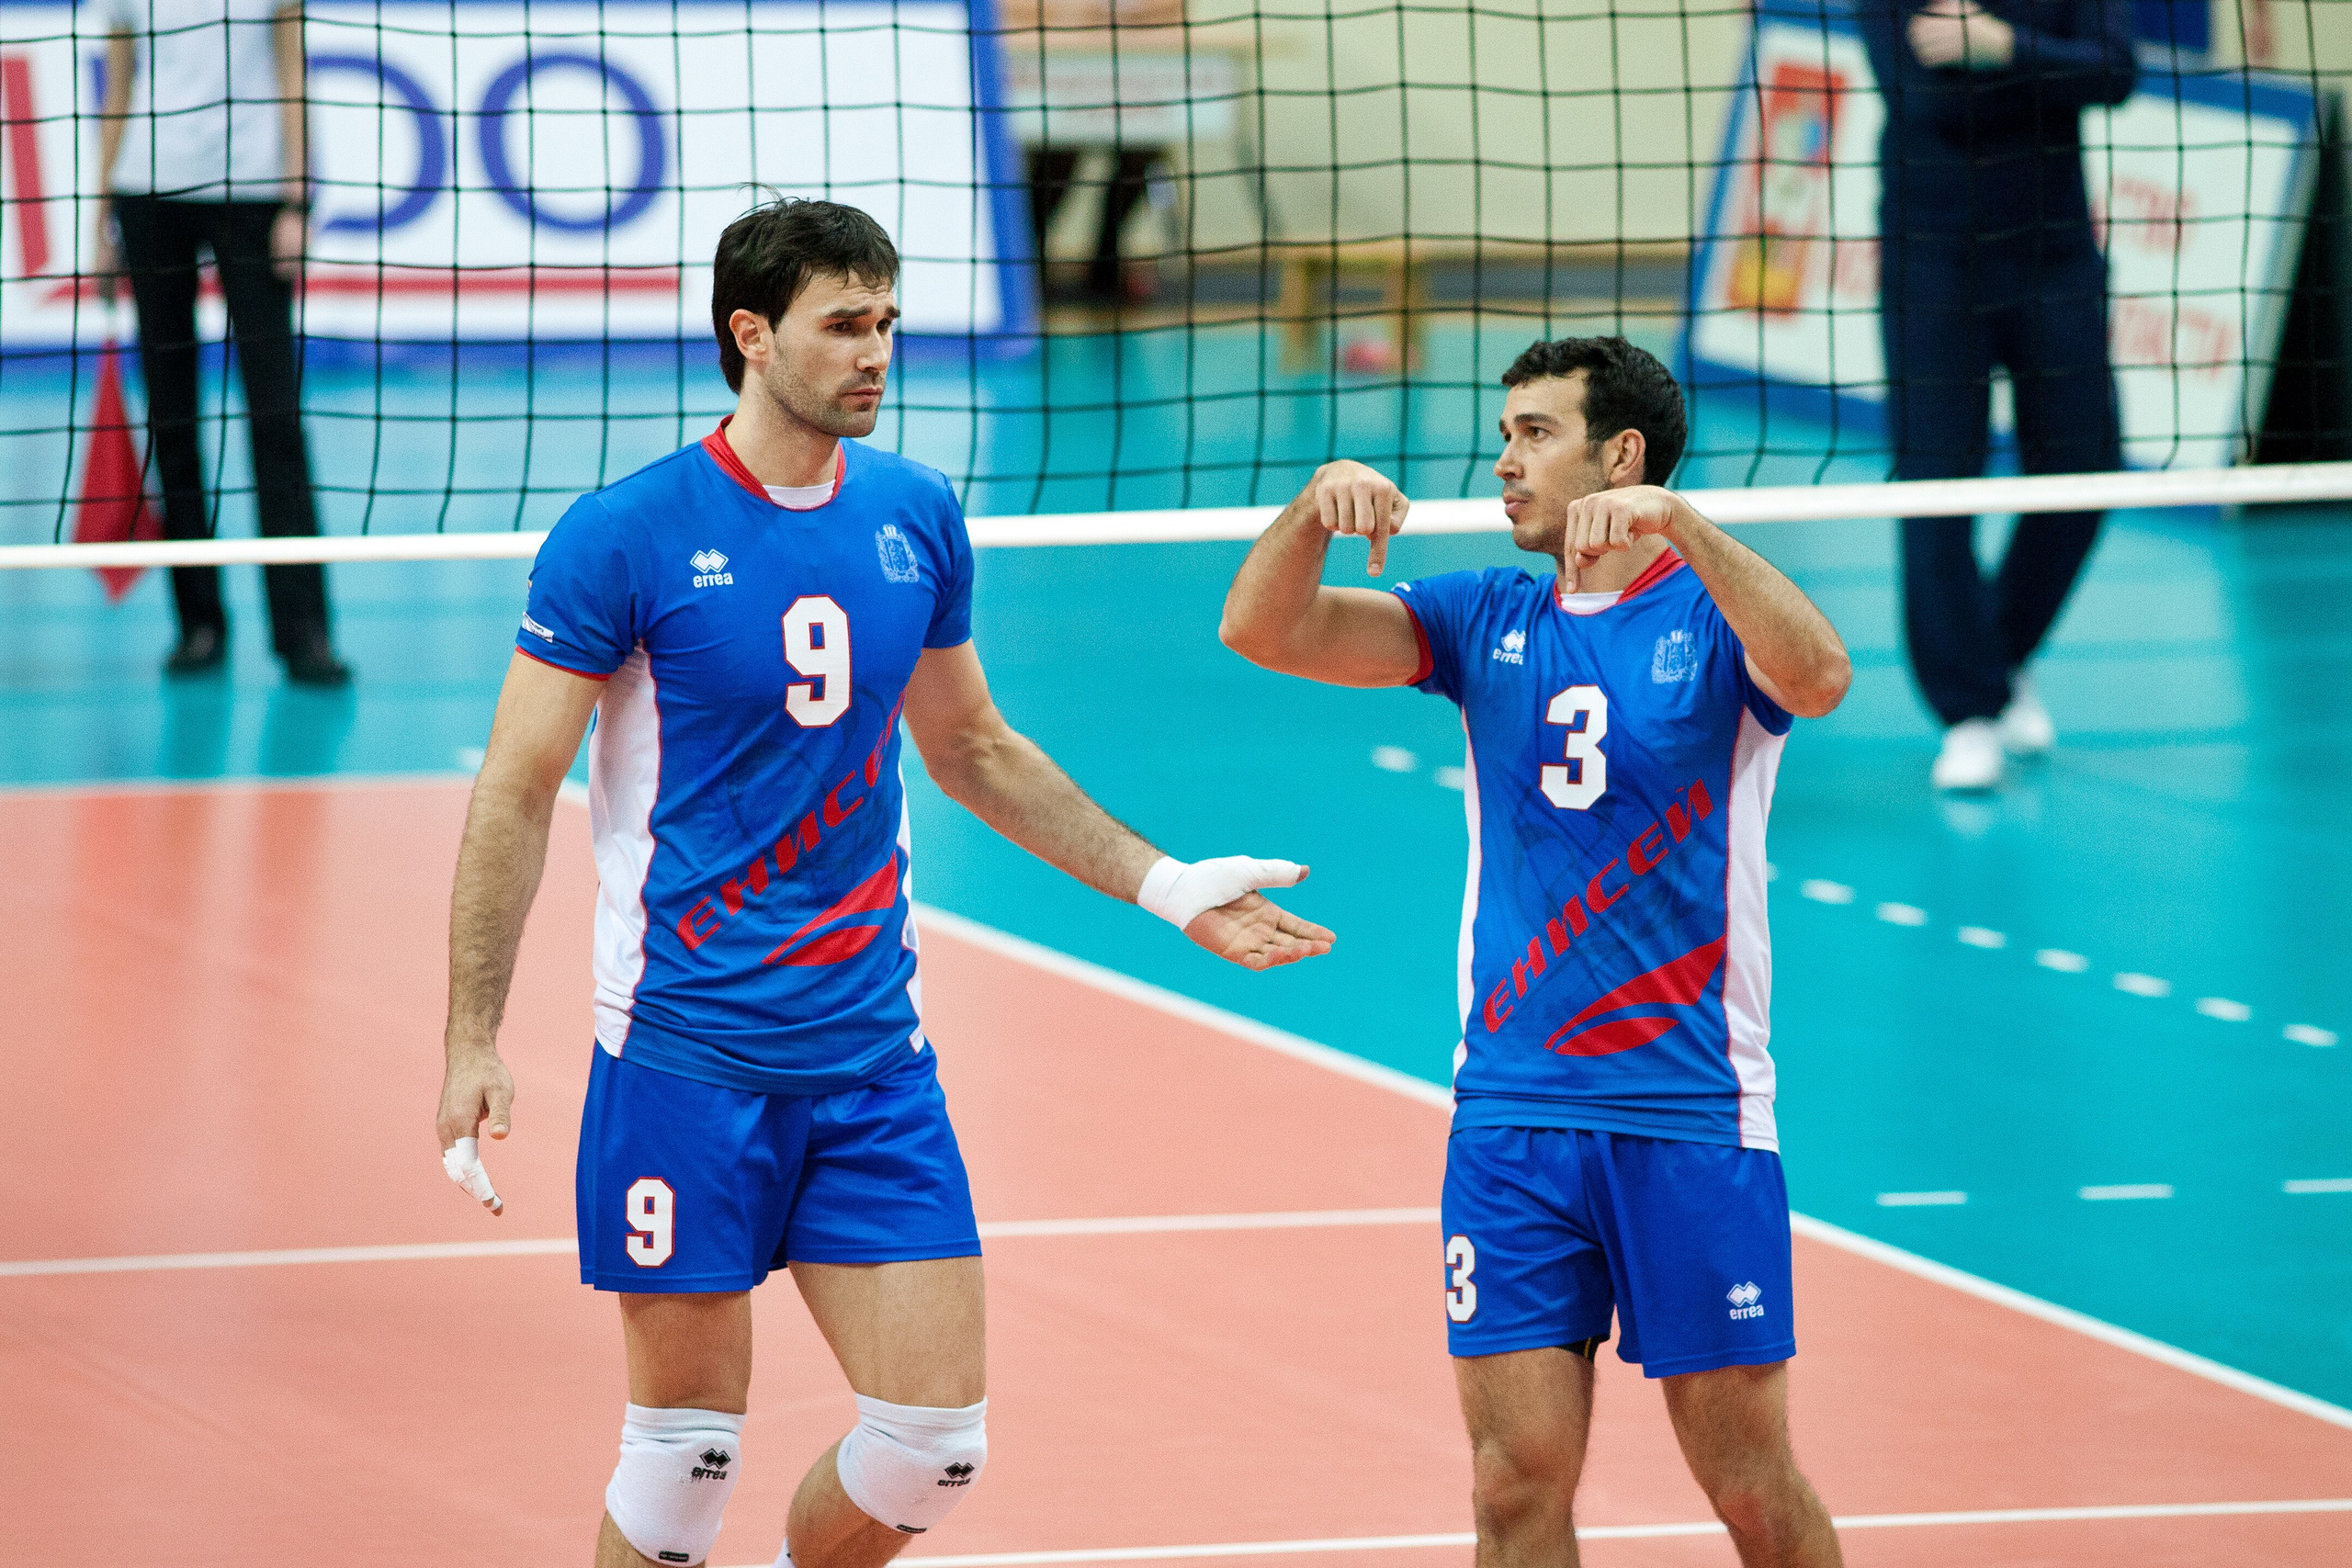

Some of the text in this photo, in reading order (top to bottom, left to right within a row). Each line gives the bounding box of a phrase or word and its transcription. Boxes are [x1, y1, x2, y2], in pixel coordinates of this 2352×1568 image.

[693, 572, 734, 588] errea
[782, 594, 853, 729] 9
[1539, 684, 1608, 811] 3
[1483, 777, 1714, 1033] ЕНИСЕЙ
[625, 1176, 676, 1269] 9
[1445, 1234, 1477, 1324] 3
[1729, 1304, 1764, 1320] errea
